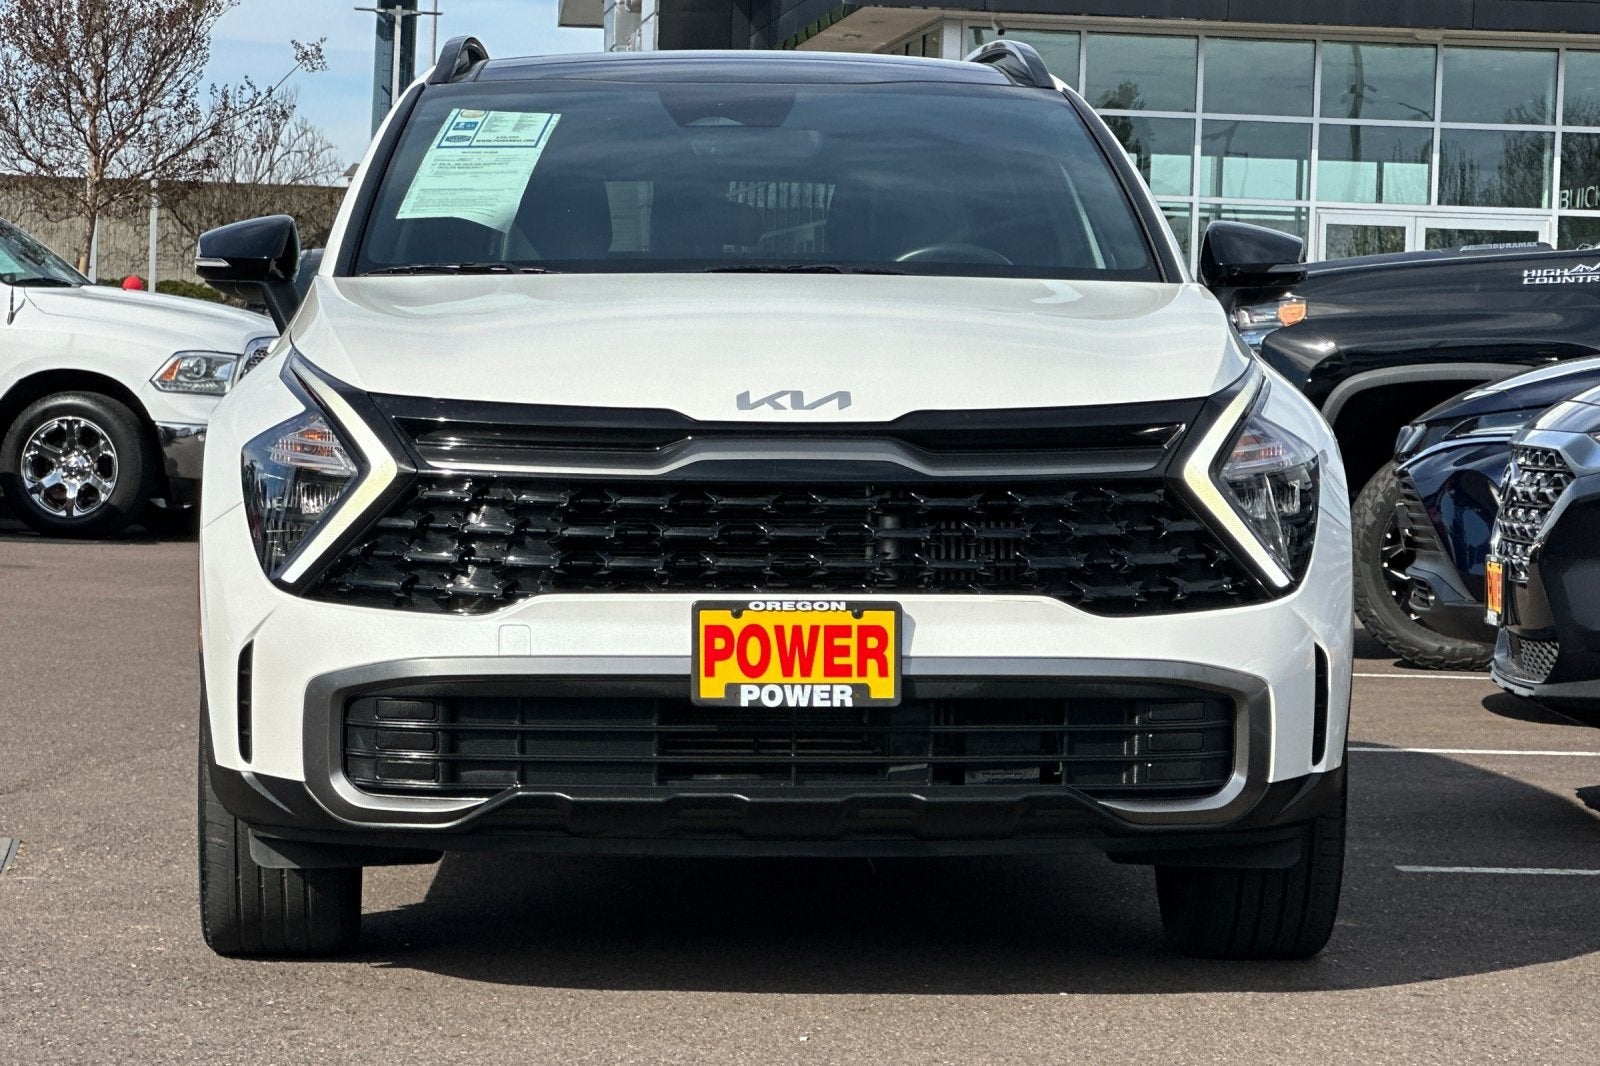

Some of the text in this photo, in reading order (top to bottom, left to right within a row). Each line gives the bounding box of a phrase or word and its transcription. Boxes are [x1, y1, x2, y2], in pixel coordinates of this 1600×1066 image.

[1523, 268, 1570, 277] HIGH
[1523, 276, 1600, 285] COUNTR
[736, 390, 851, 410] KIA
[749, 601, 846, 612] OREGON
[704, 624, 889, 679] POWER
[740, 685, 853, 707] POWER
